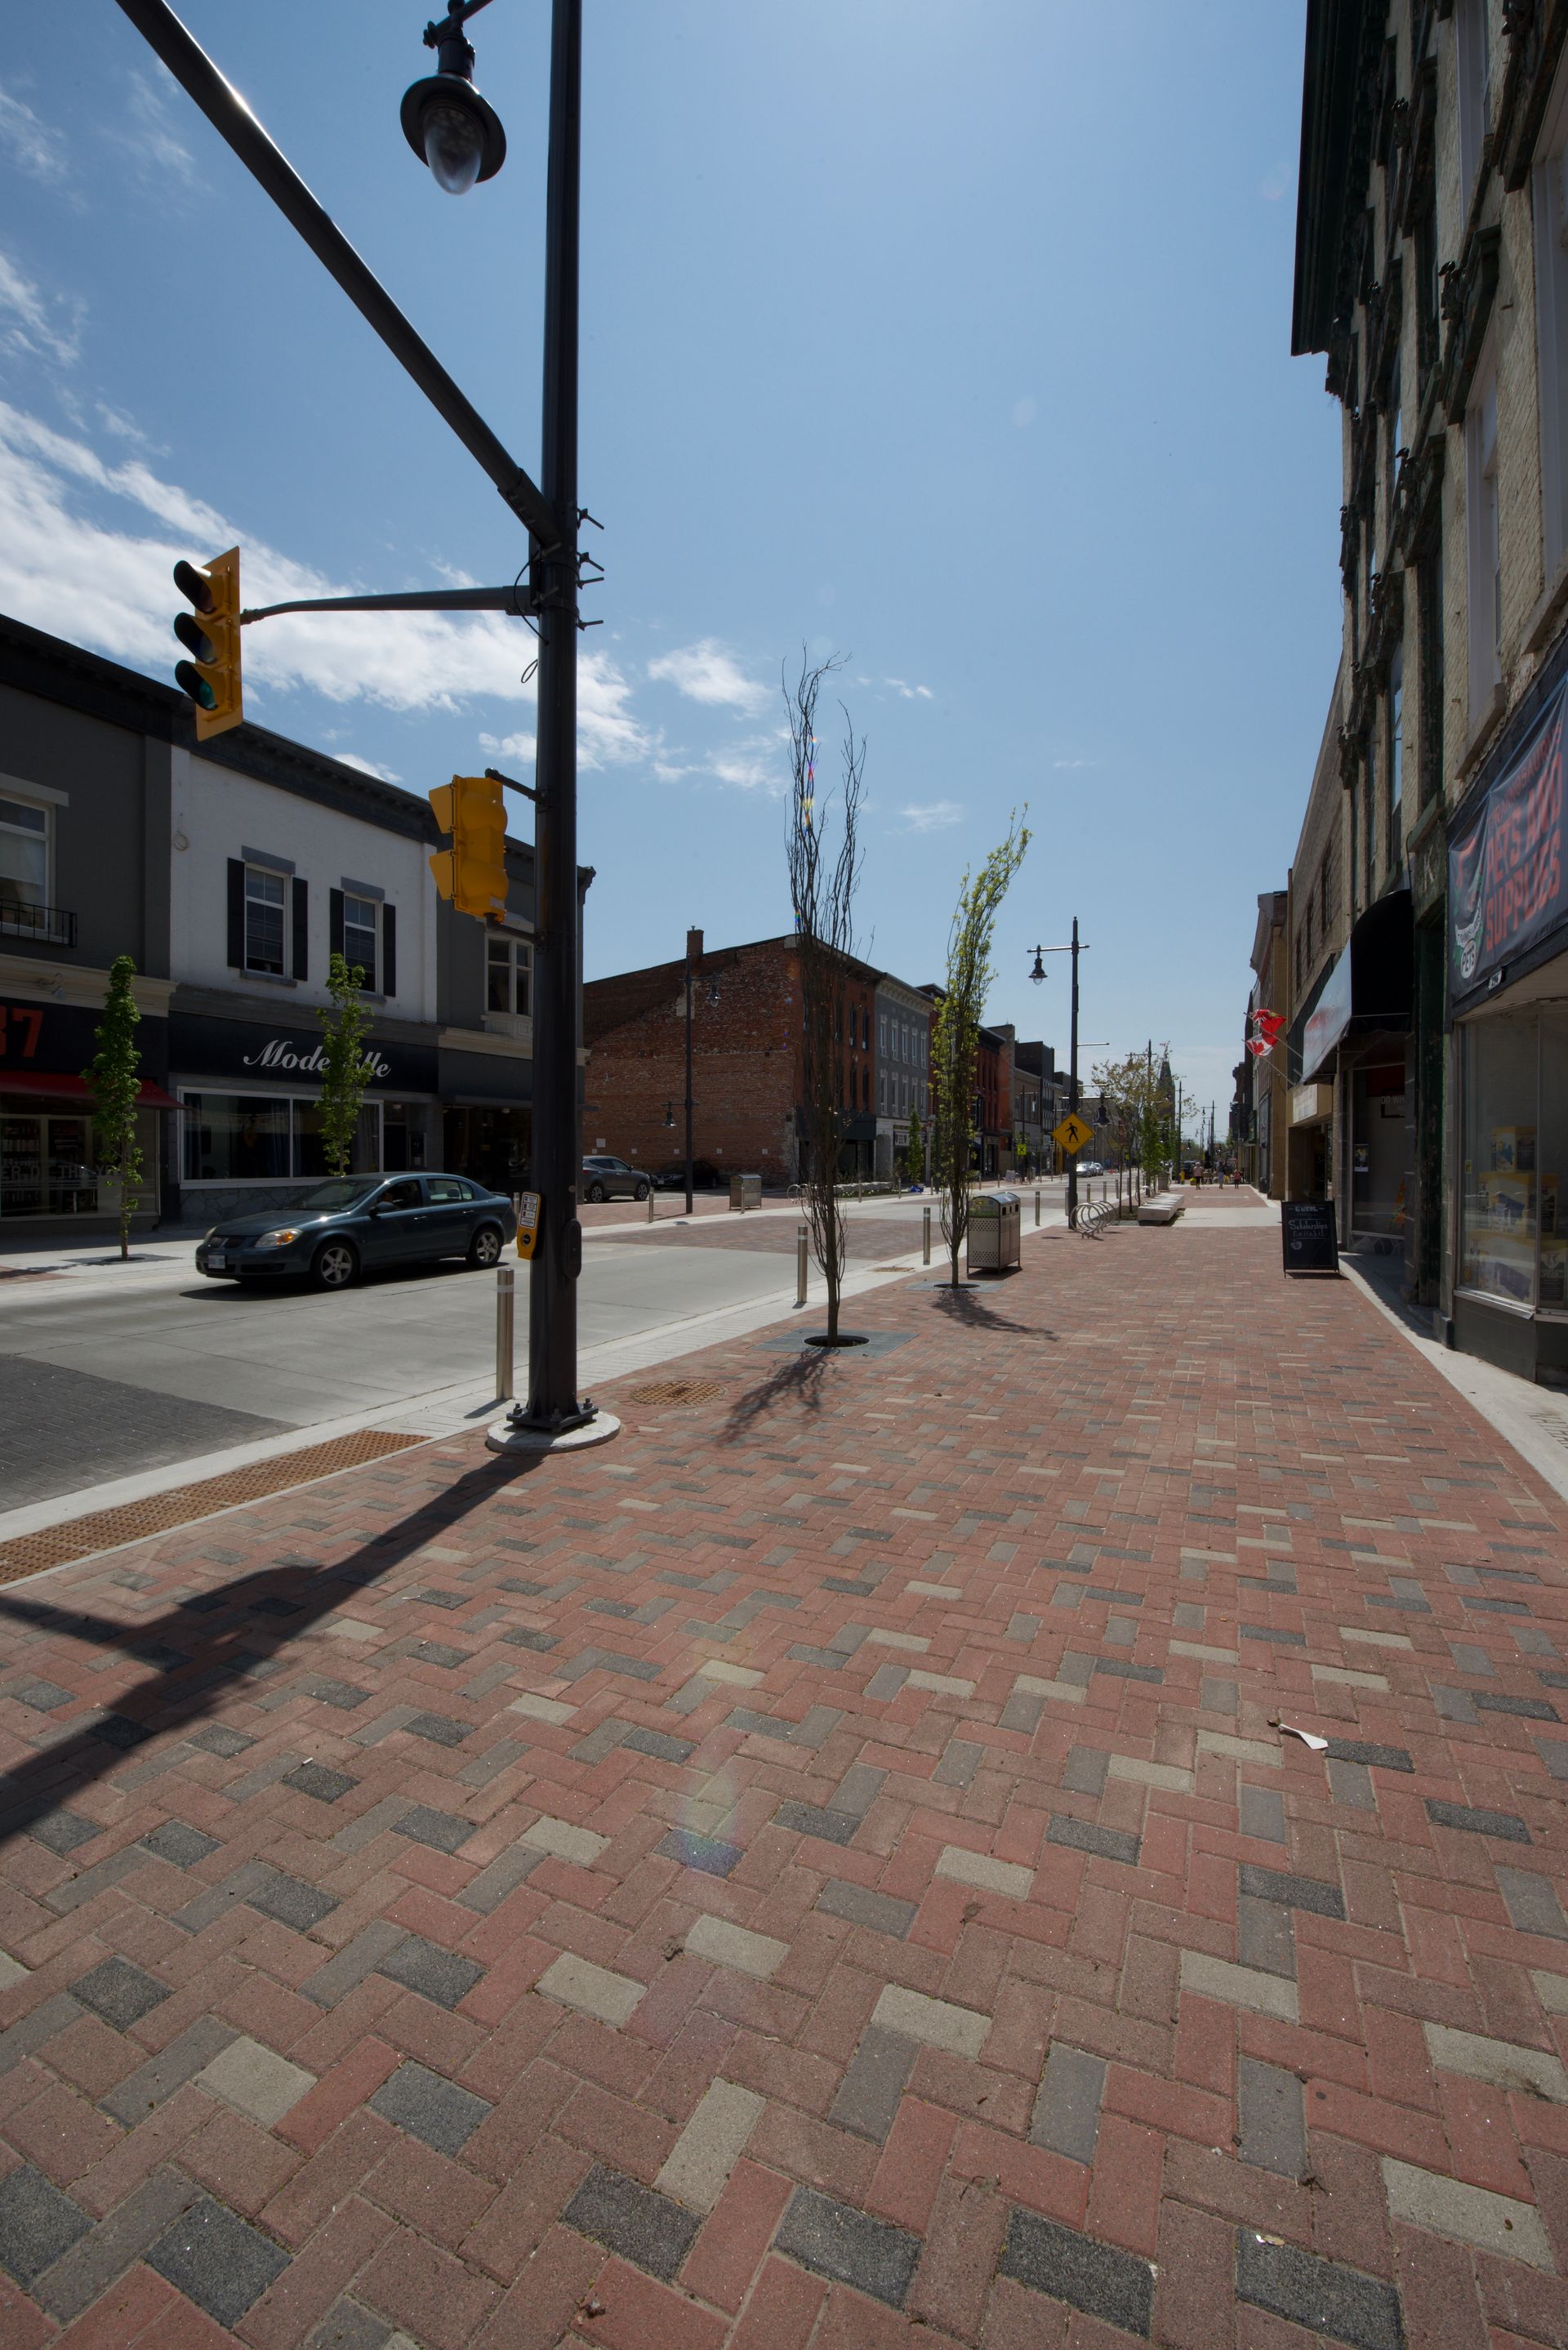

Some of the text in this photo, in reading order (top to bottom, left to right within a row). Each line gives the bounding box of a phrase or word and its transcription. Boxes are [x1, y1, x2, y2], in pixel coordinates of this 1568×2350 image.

[1486, 751, 1561, 896] PETS AND
[1486, 828, 1560, 954] SUPPLIES
[1463, 945, 1475, 973] PETS
[0, 1006, 45, 1059] 7
[243, 1039, 331, 1072] Mode
